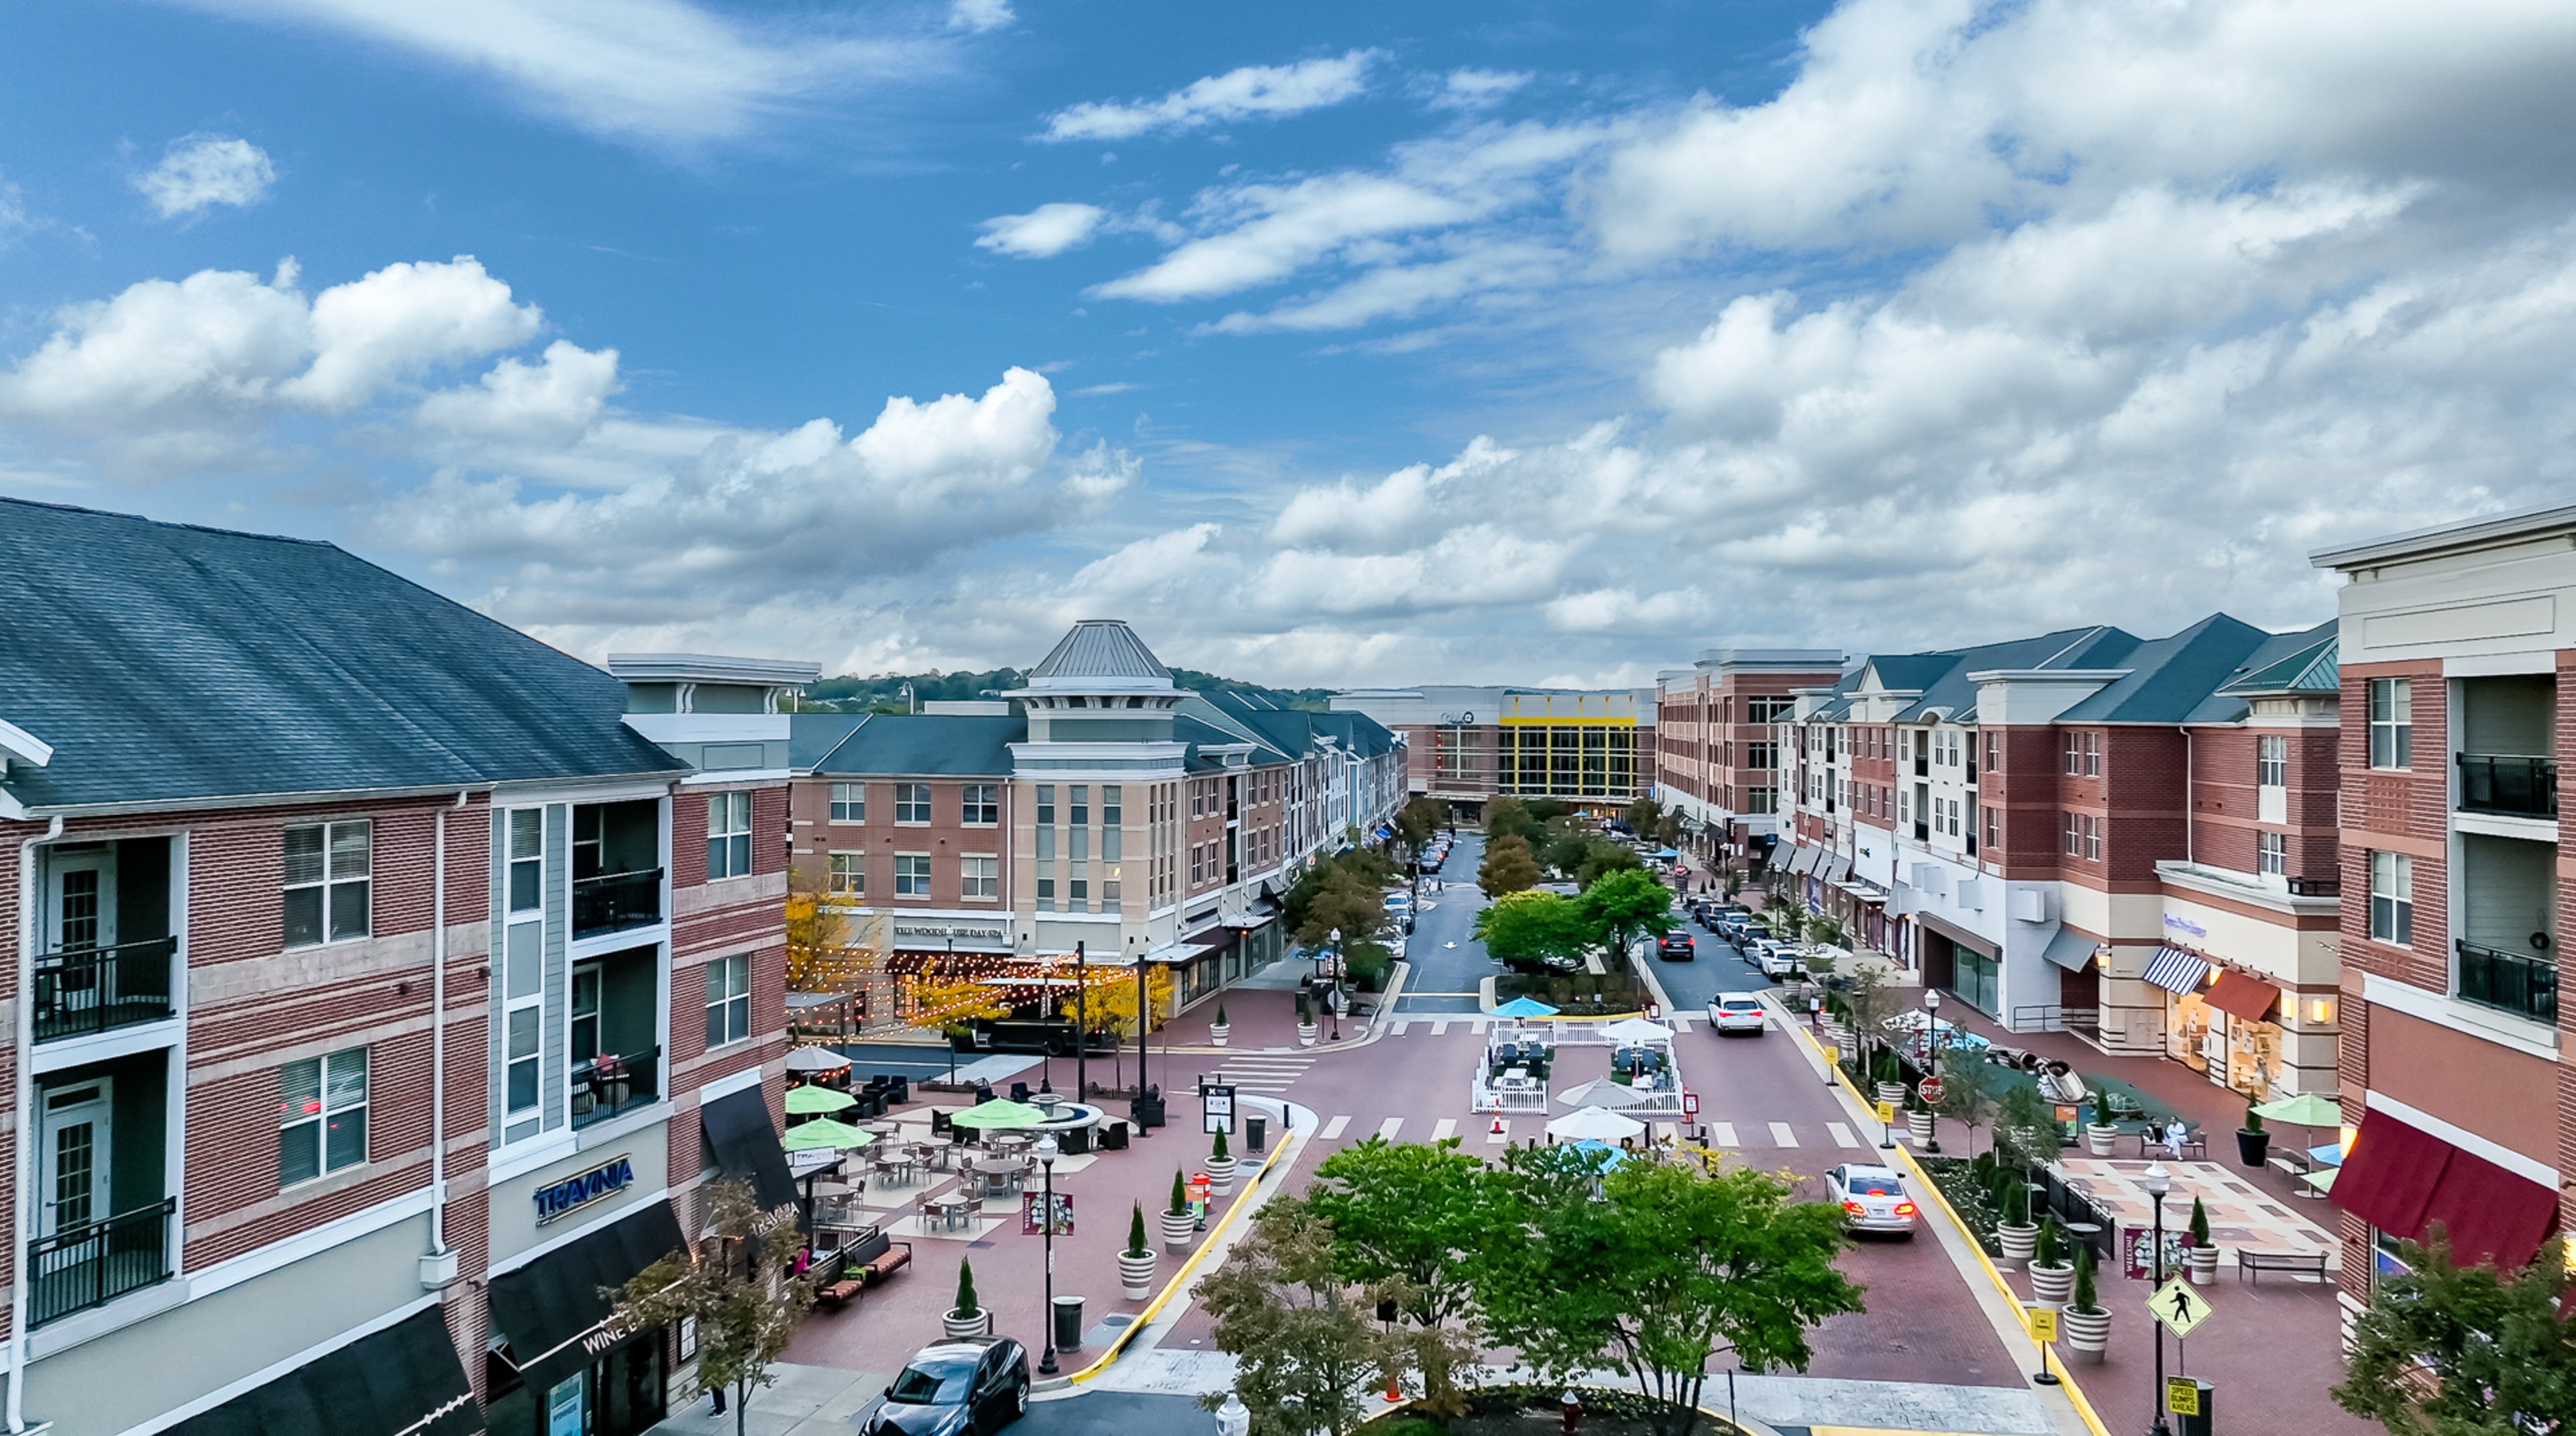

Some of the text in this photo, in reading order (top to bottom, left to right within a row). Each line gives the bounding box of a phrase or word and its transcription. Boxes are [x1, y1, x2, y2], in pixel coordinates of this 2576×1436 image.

[914, 928, 969, 936] WOODHUSE
[533, 1158, 634, 1218] TRAVINIA
[582, 1328, 626, 1355] WINE
